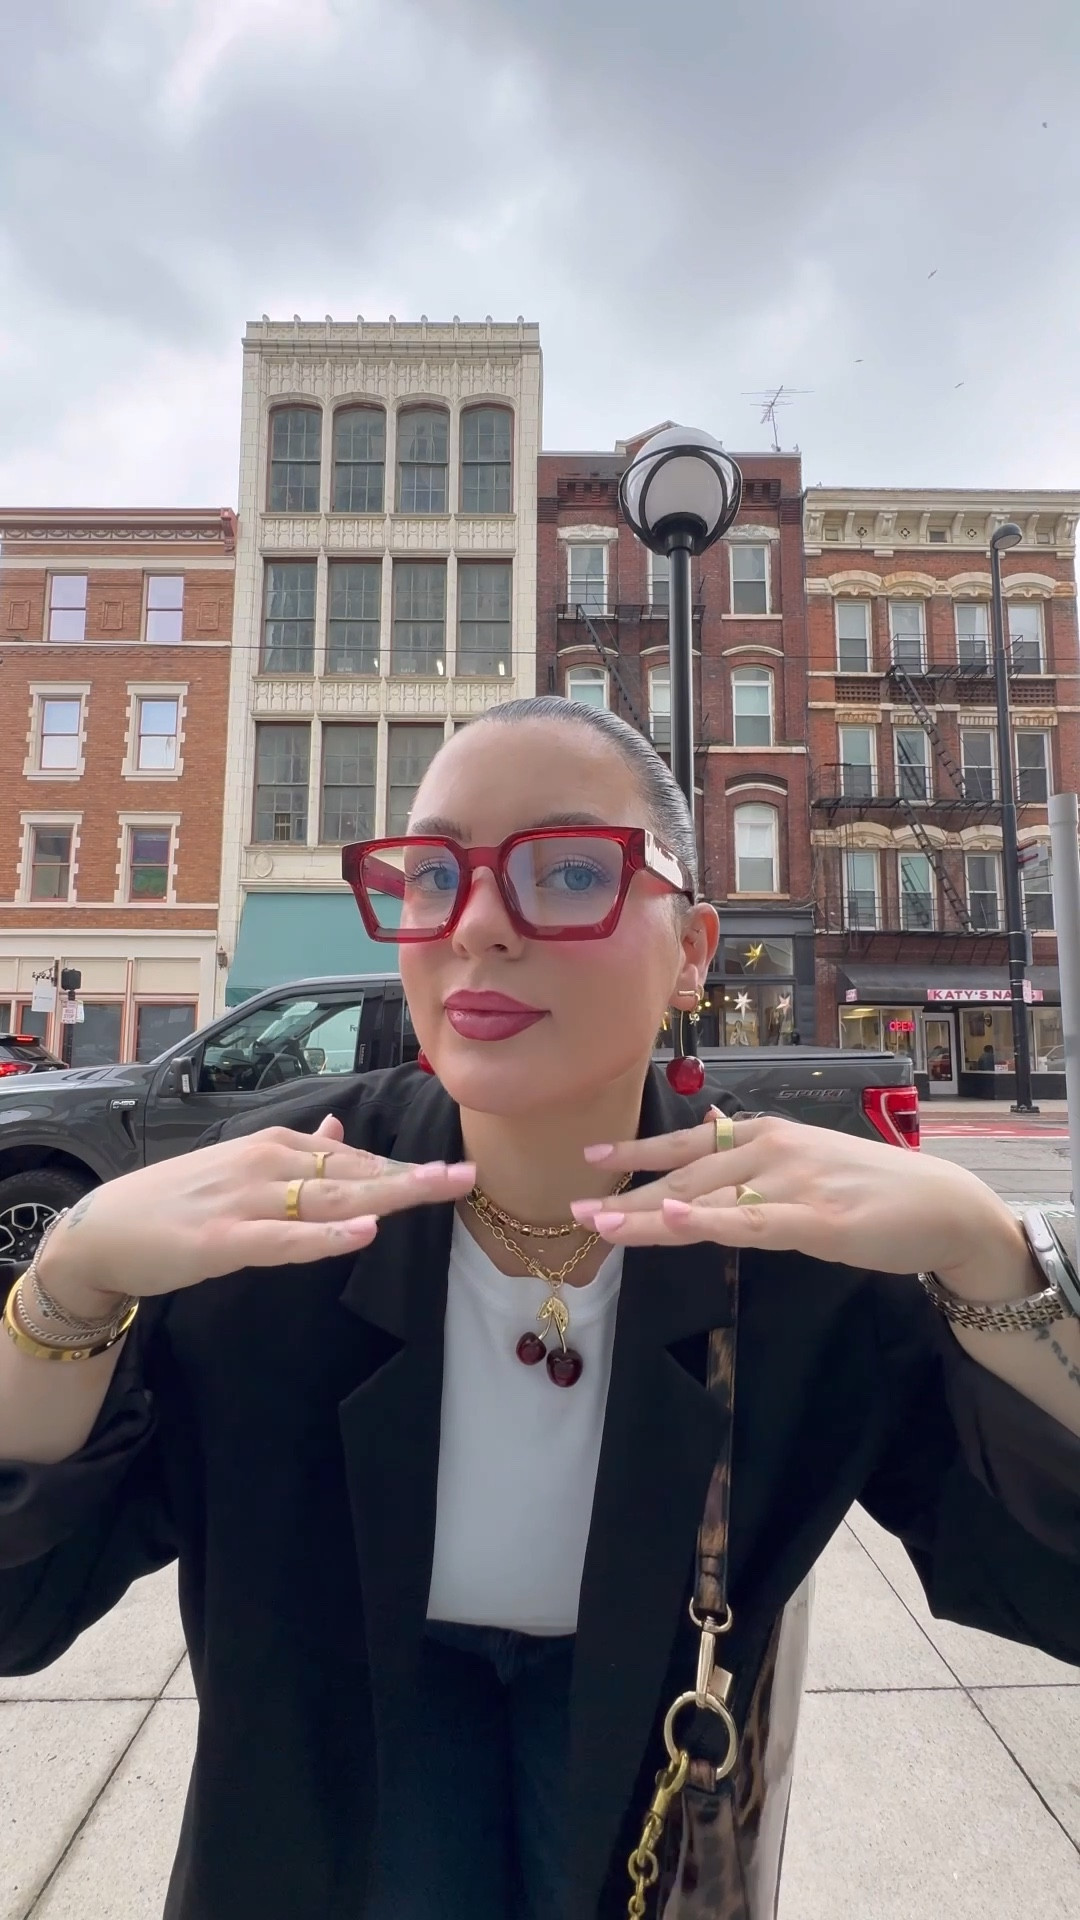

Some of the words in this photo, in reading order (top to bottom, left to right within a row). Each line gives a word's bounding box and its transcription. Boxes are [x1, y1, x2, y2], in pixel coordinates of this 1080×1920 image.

[933, 990, 988, 1000] KATY'S
[992, 990, 1036, 1000] NAS
[889, 1021, 915, 1031] OPEN
[777, 1089, 851, 1100] SPORT
